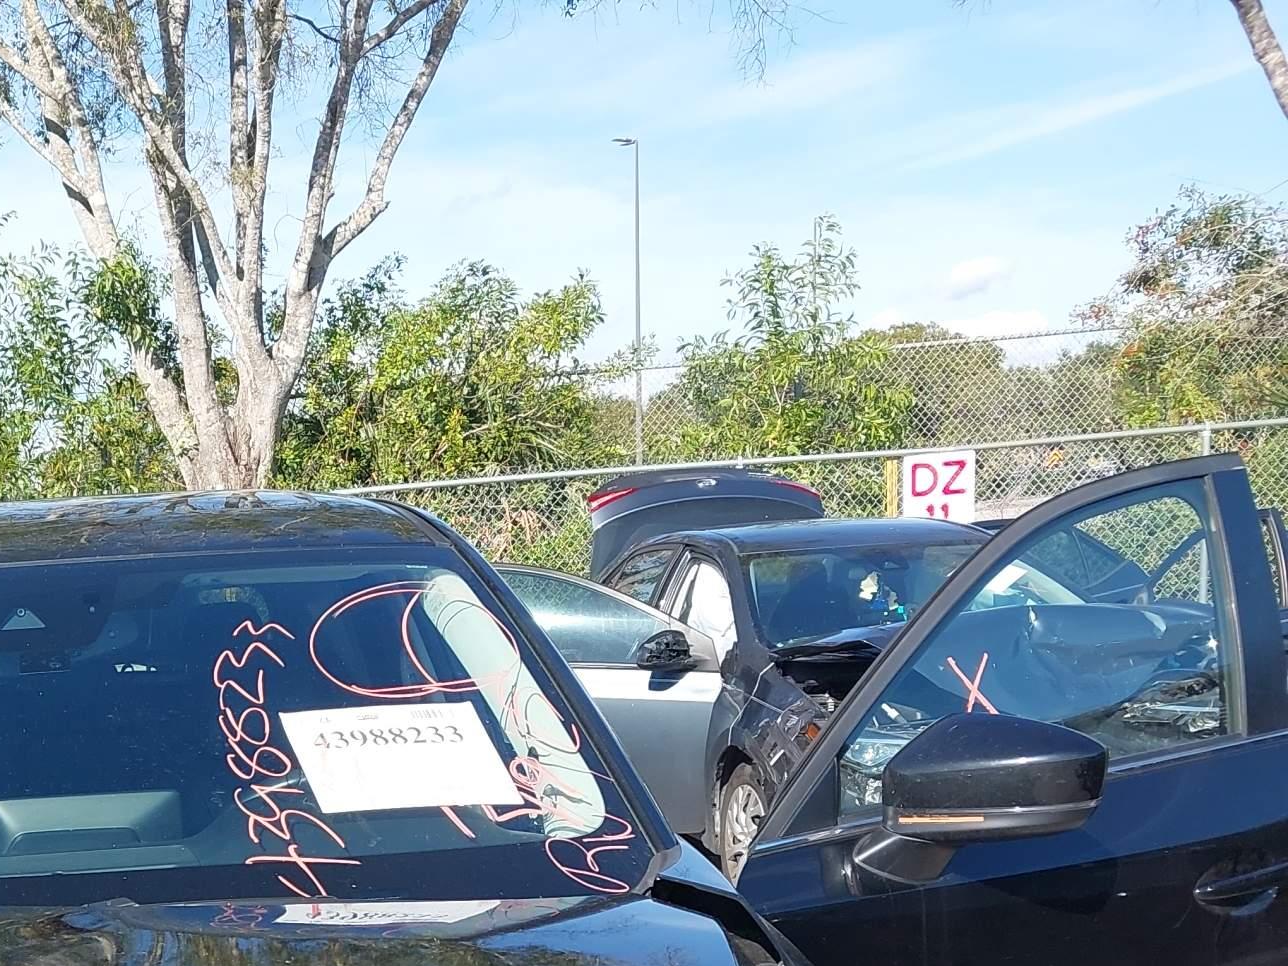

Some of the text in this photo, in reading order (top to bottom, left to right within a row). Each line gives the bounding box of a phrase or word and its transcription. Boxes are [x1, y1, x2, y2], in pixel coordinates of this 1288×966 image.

[912, 460, 967, 497] DZ
[313, 725, 464, 749] 43988233
[214, 619, 361, 898] 43988233
